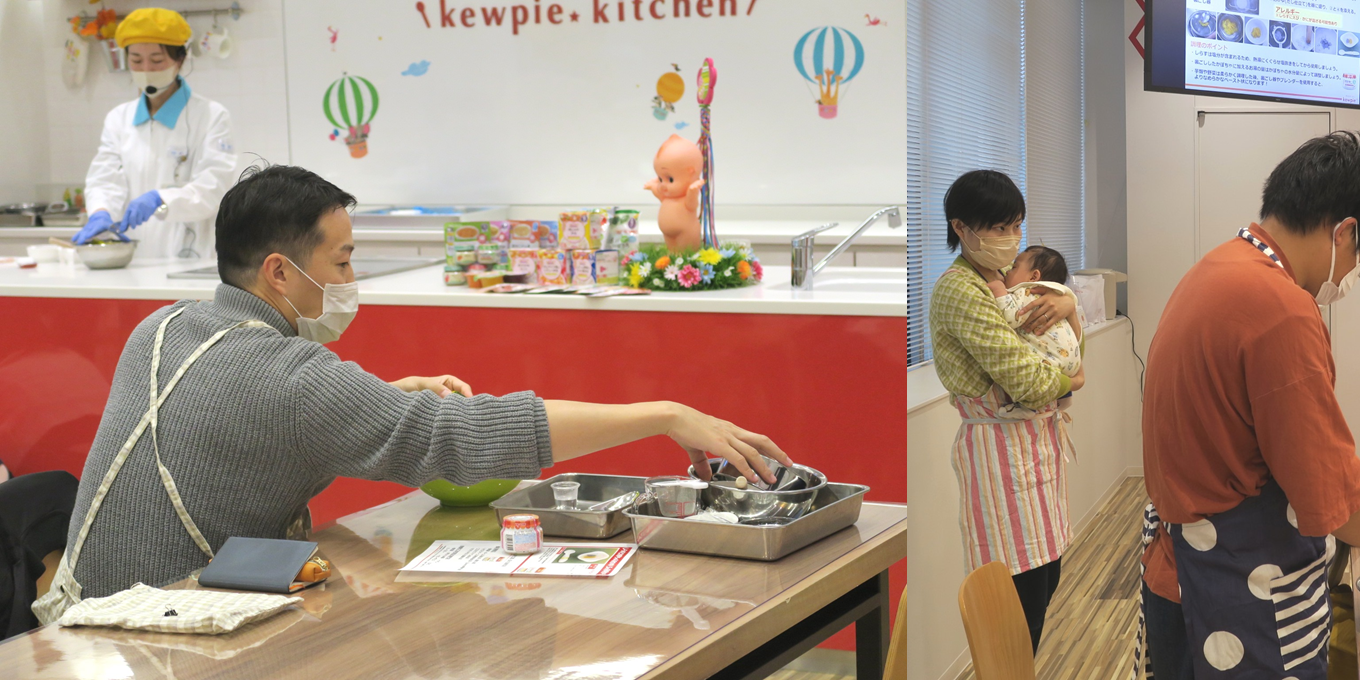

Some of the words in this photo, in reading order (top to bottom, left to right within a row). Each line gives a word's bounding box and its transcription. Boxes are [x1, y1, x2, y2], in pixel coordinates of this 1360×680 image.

[440, 0, 564, 35] kewpie
[1190, 40, 1228, 51] 調理のポイント
